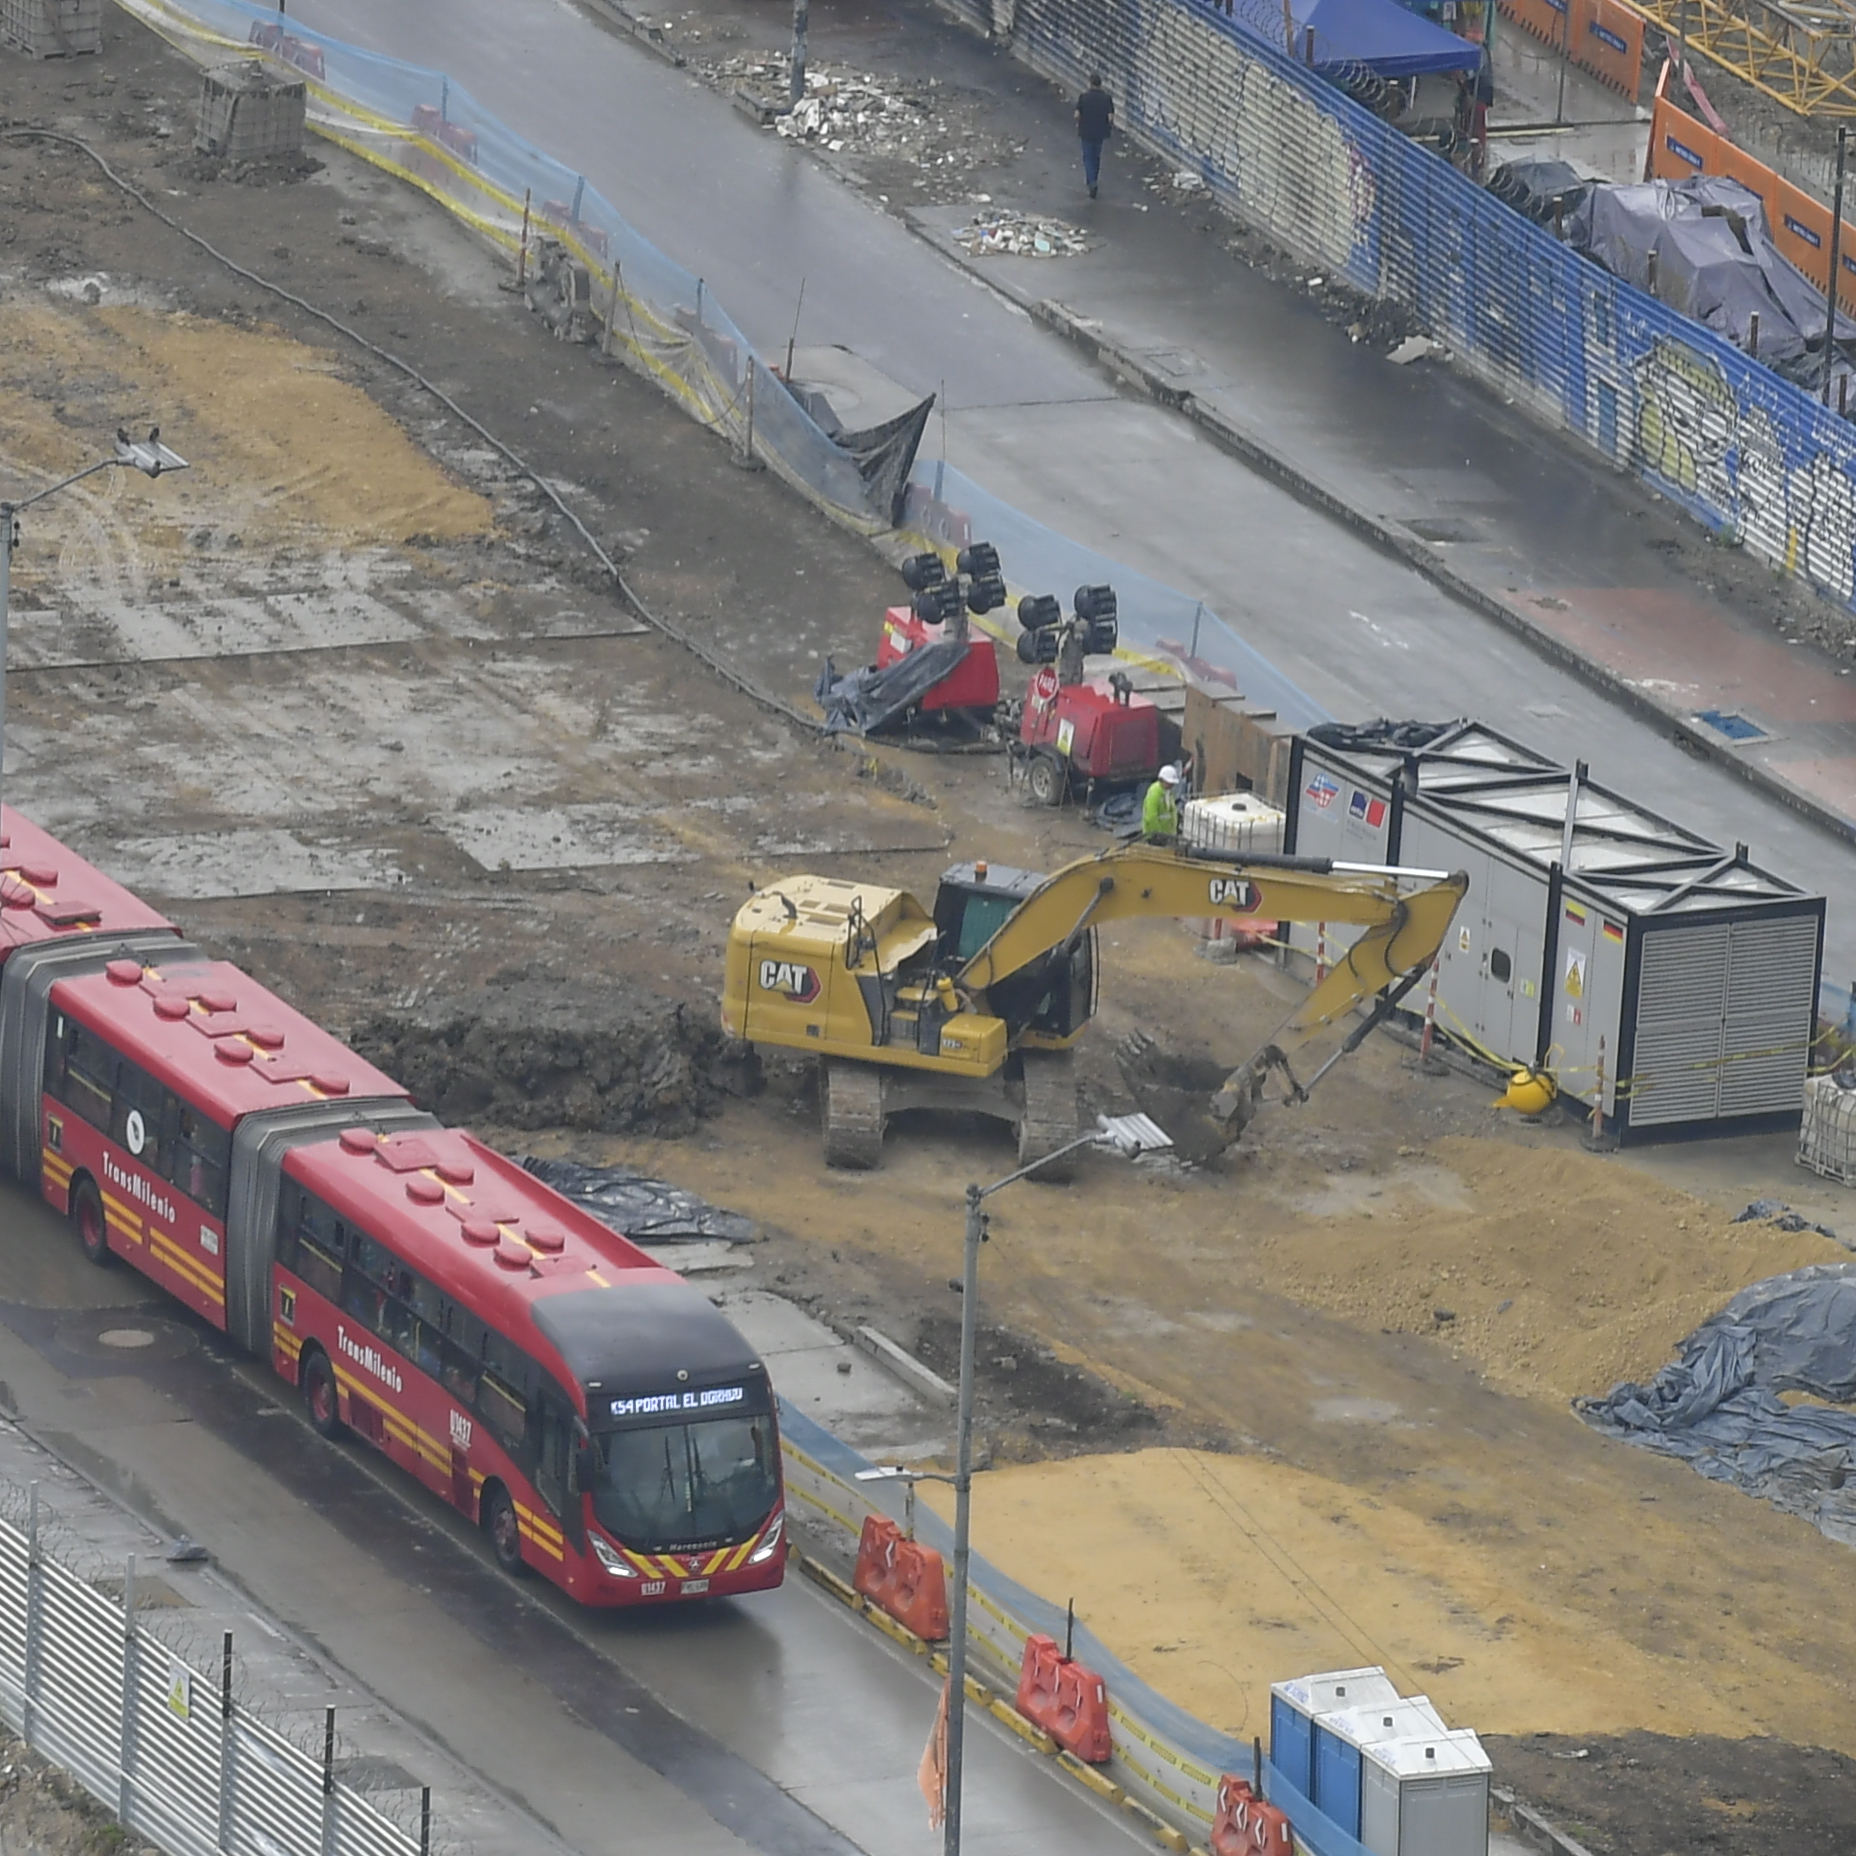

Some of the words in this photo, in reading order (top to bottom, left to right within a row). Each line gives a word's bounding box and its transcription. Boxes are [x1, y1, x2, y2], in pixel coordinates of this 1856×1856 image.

[1038, 673, 1056, 693] PARE
[1209, 878, 1250, 906] CAT
[760, 959, 807, 994] CAT
[103, 1151, 176, 1223] TransMilenio
[338, 1325, 403, 1393] TransMilenio
[636, 1394, 681, 1413] PORTAL
[683, 1392, 698, 1408] EL
[700, 1387, 744, 1406] DORADO
